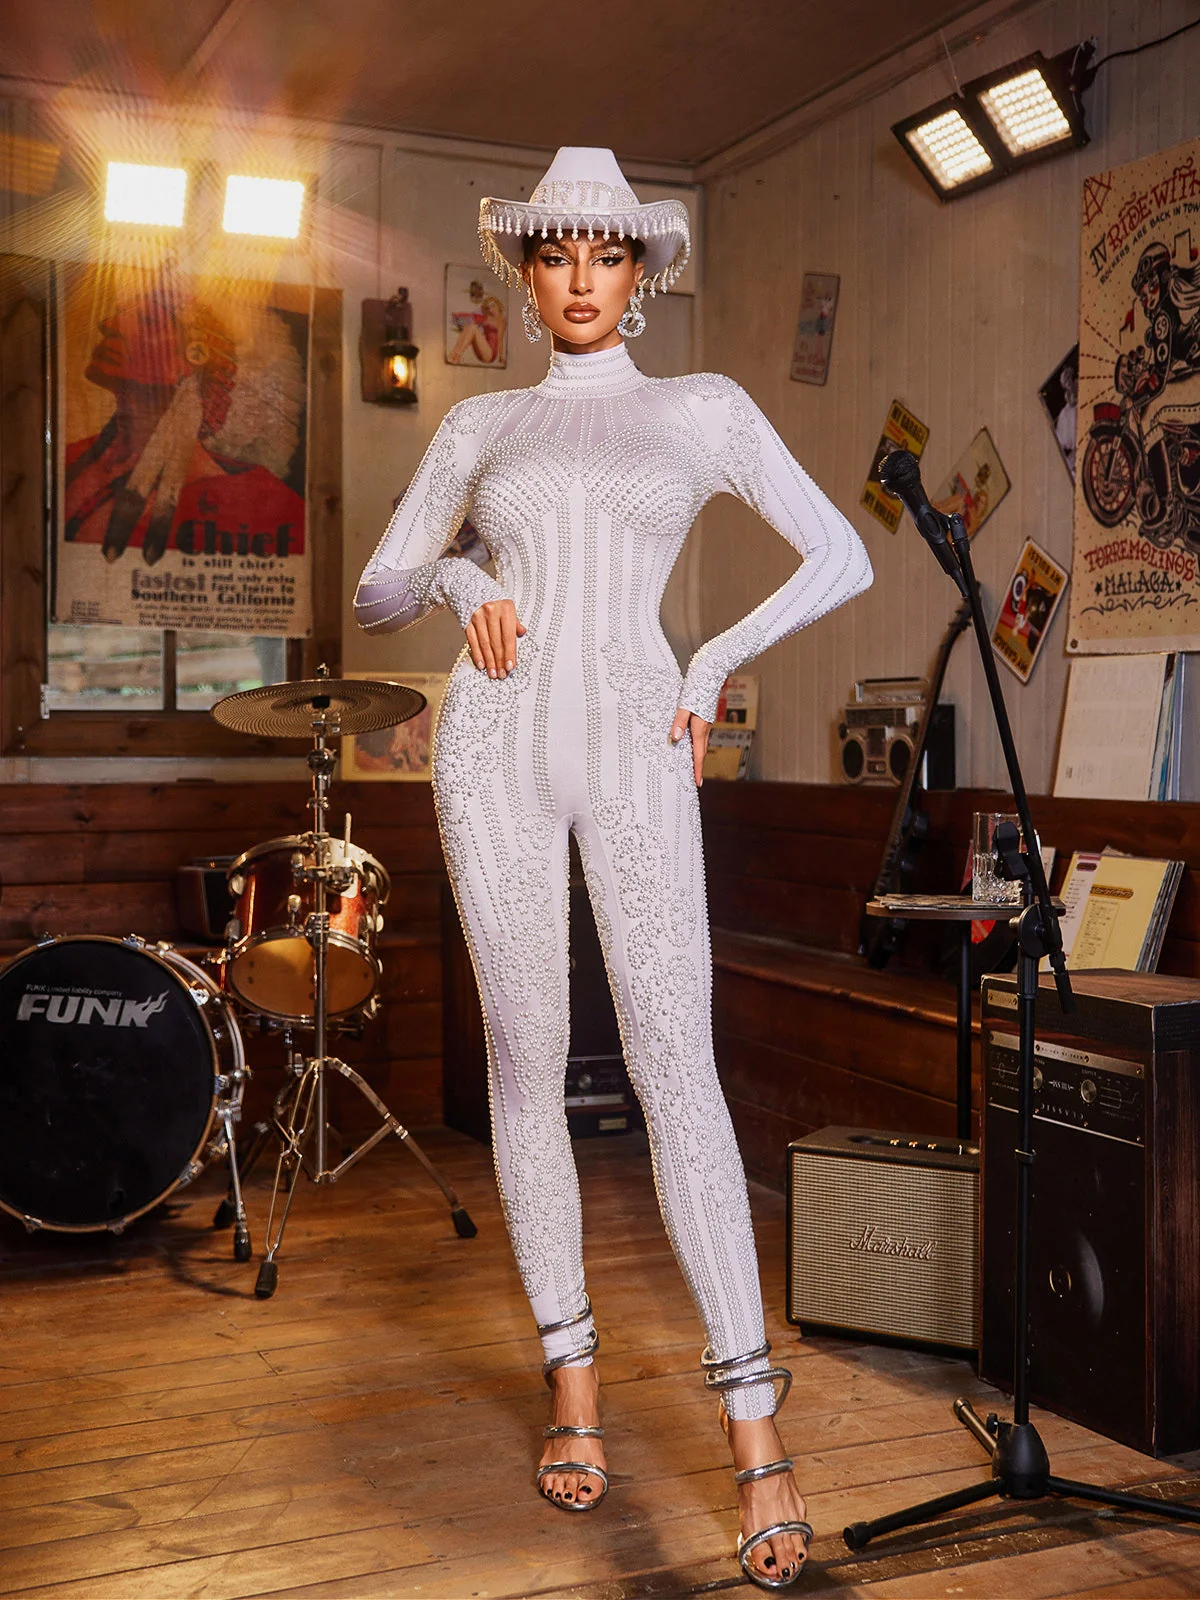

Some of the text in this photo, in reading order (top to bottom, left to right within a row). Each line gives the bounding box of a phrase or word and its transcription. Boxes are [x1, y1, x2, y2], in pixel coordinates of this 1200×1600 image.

[1133, 226, 1148, 246] ARE
[1149, 210, 1171, 229] BACK
[1173, 205, 1181, 217] IN
[1156, 317, 1167, 335] 59
[175, 519, 297, 558] Chief
[204, 558, 233, 569] still
[1083, 538, 1196, 581] TORREMOLINOS
[131, 588, 296, 607] Southern California
[93, 988, 123, 997] company
[16, 990, 169, 1027] FUNK
[1041, 1103, 1085, 1120] CLASSIC
[849, 1224, 938, 1260] Marshall
